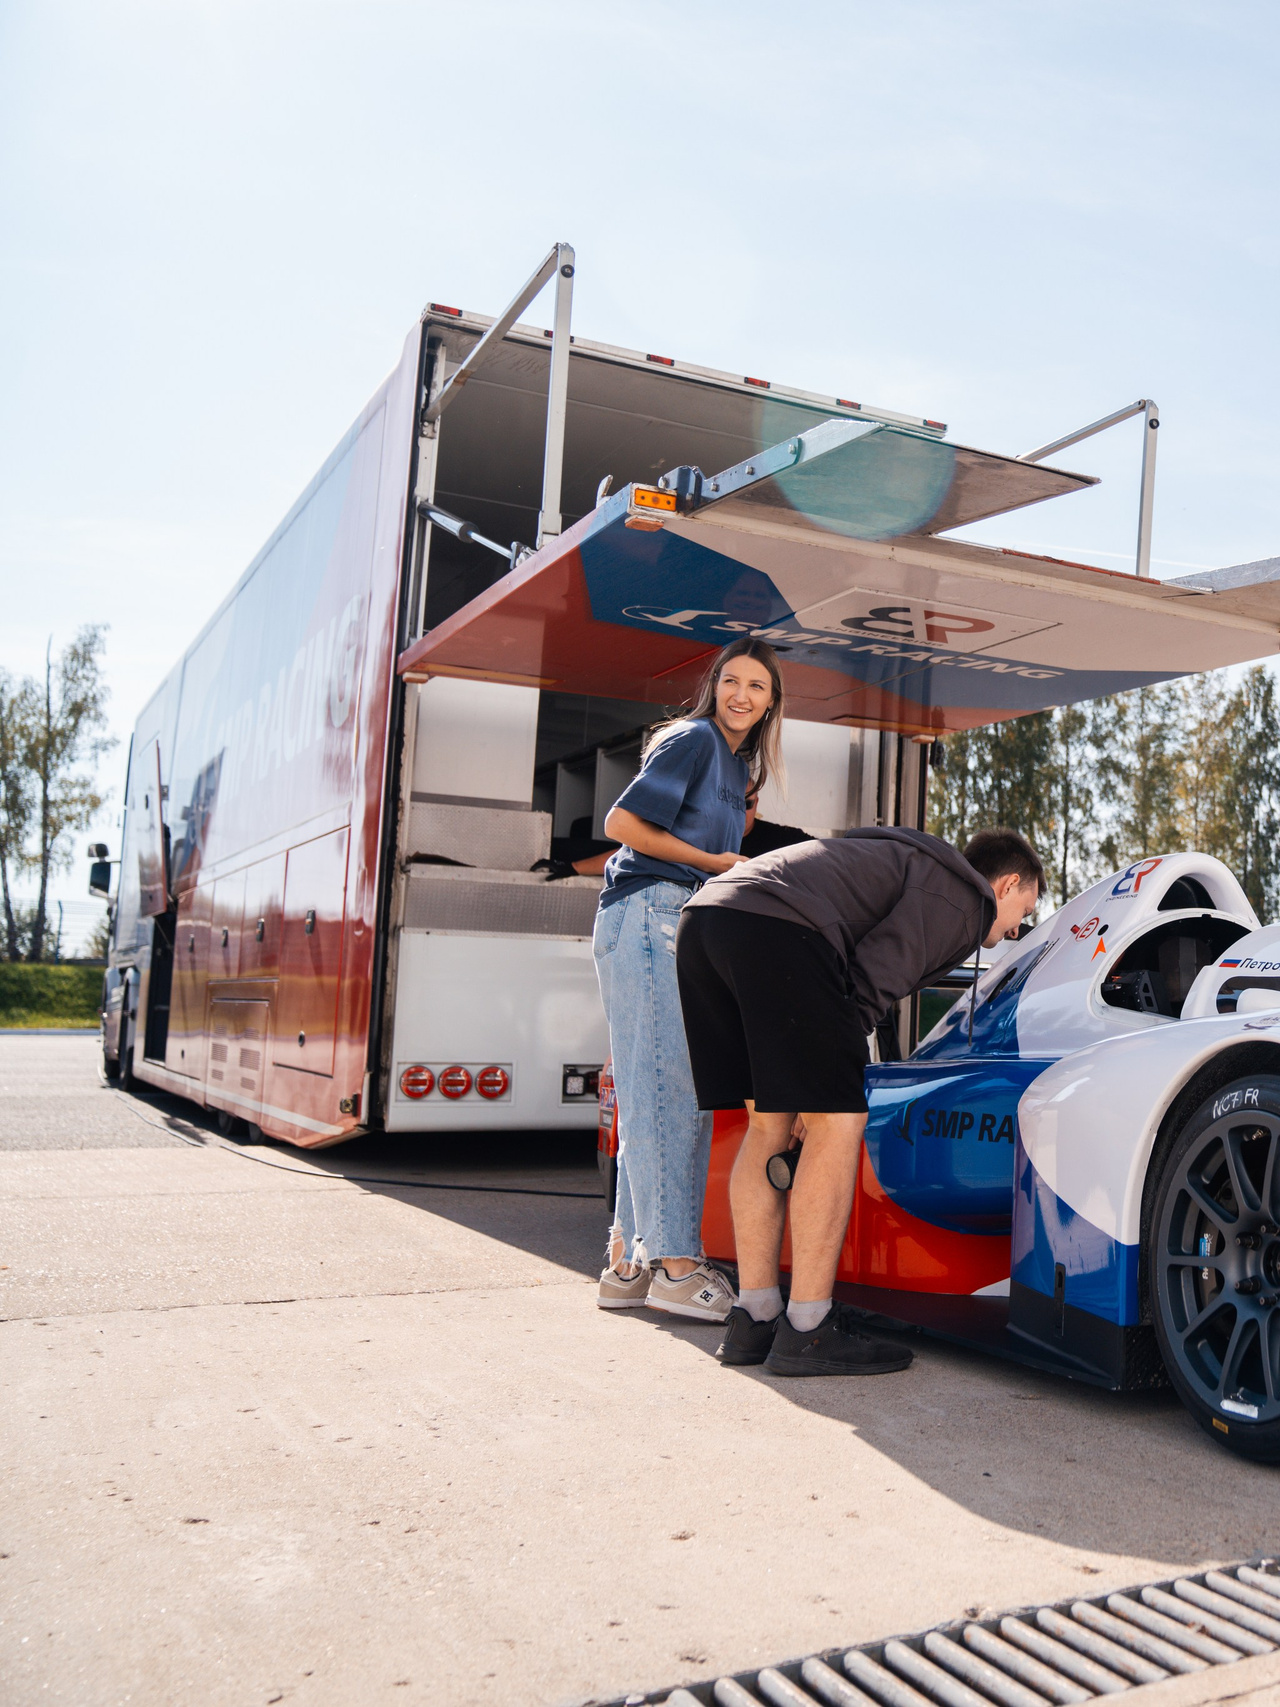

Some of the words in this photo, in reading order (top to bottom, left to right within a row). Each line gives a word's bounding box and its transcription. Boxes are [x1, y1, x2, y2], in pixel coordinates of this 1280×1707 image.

[711, 621, 853, 645] SMP
[850, 644, 1065, 679] RACING
[824, 626, 944, 647] ENGINEERING
[251, 594, 363, 786] RACING
[1244, 1087, 1260, 1107] FR
[921, 1109, 974, 1139] SMP
